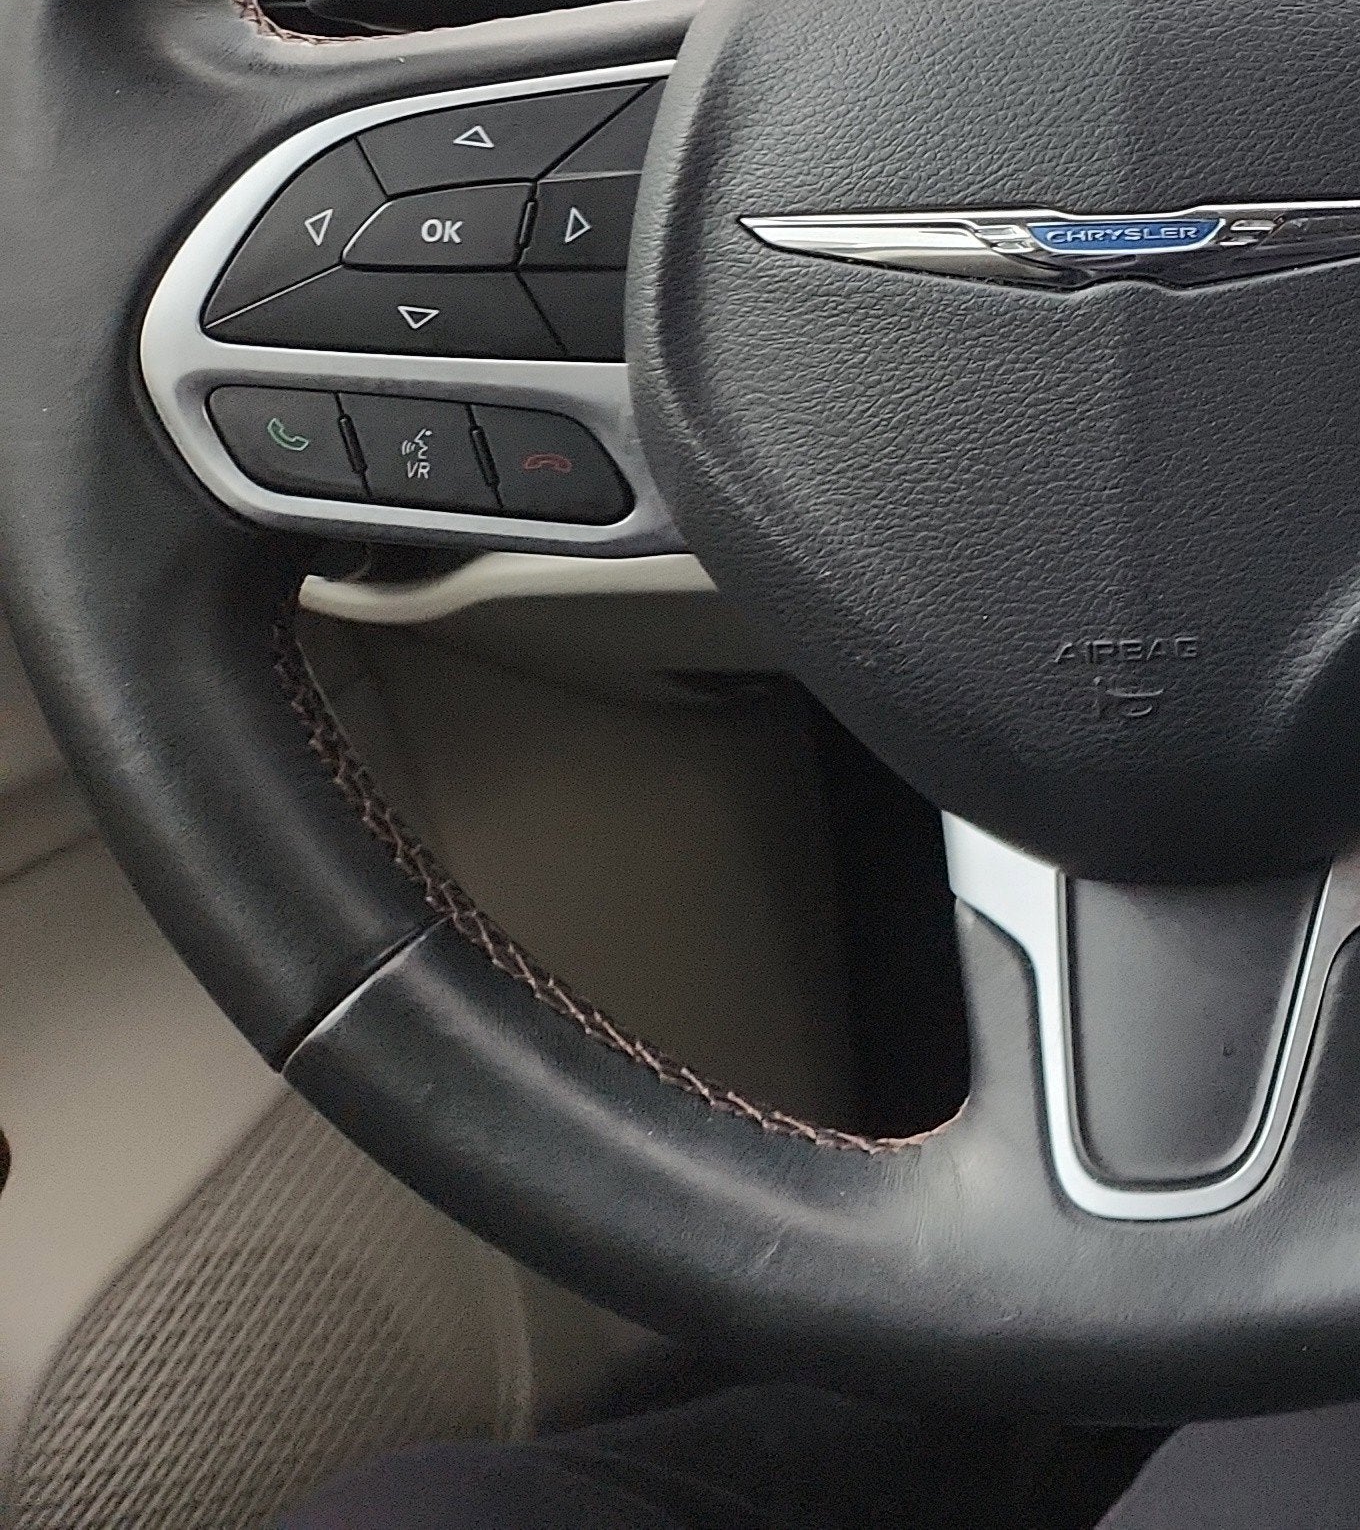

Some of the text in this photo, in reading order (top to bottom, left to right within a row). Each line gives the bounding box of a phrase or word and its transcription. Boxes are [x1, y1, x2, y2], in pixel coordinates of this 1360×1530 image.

[421, 218, 462, 243] OK
[1047, 225, 1198, 244] CHRYSLER
[406, 462, 431, 479] VR
[1056, 637, 1196, 665] AIRBAG
